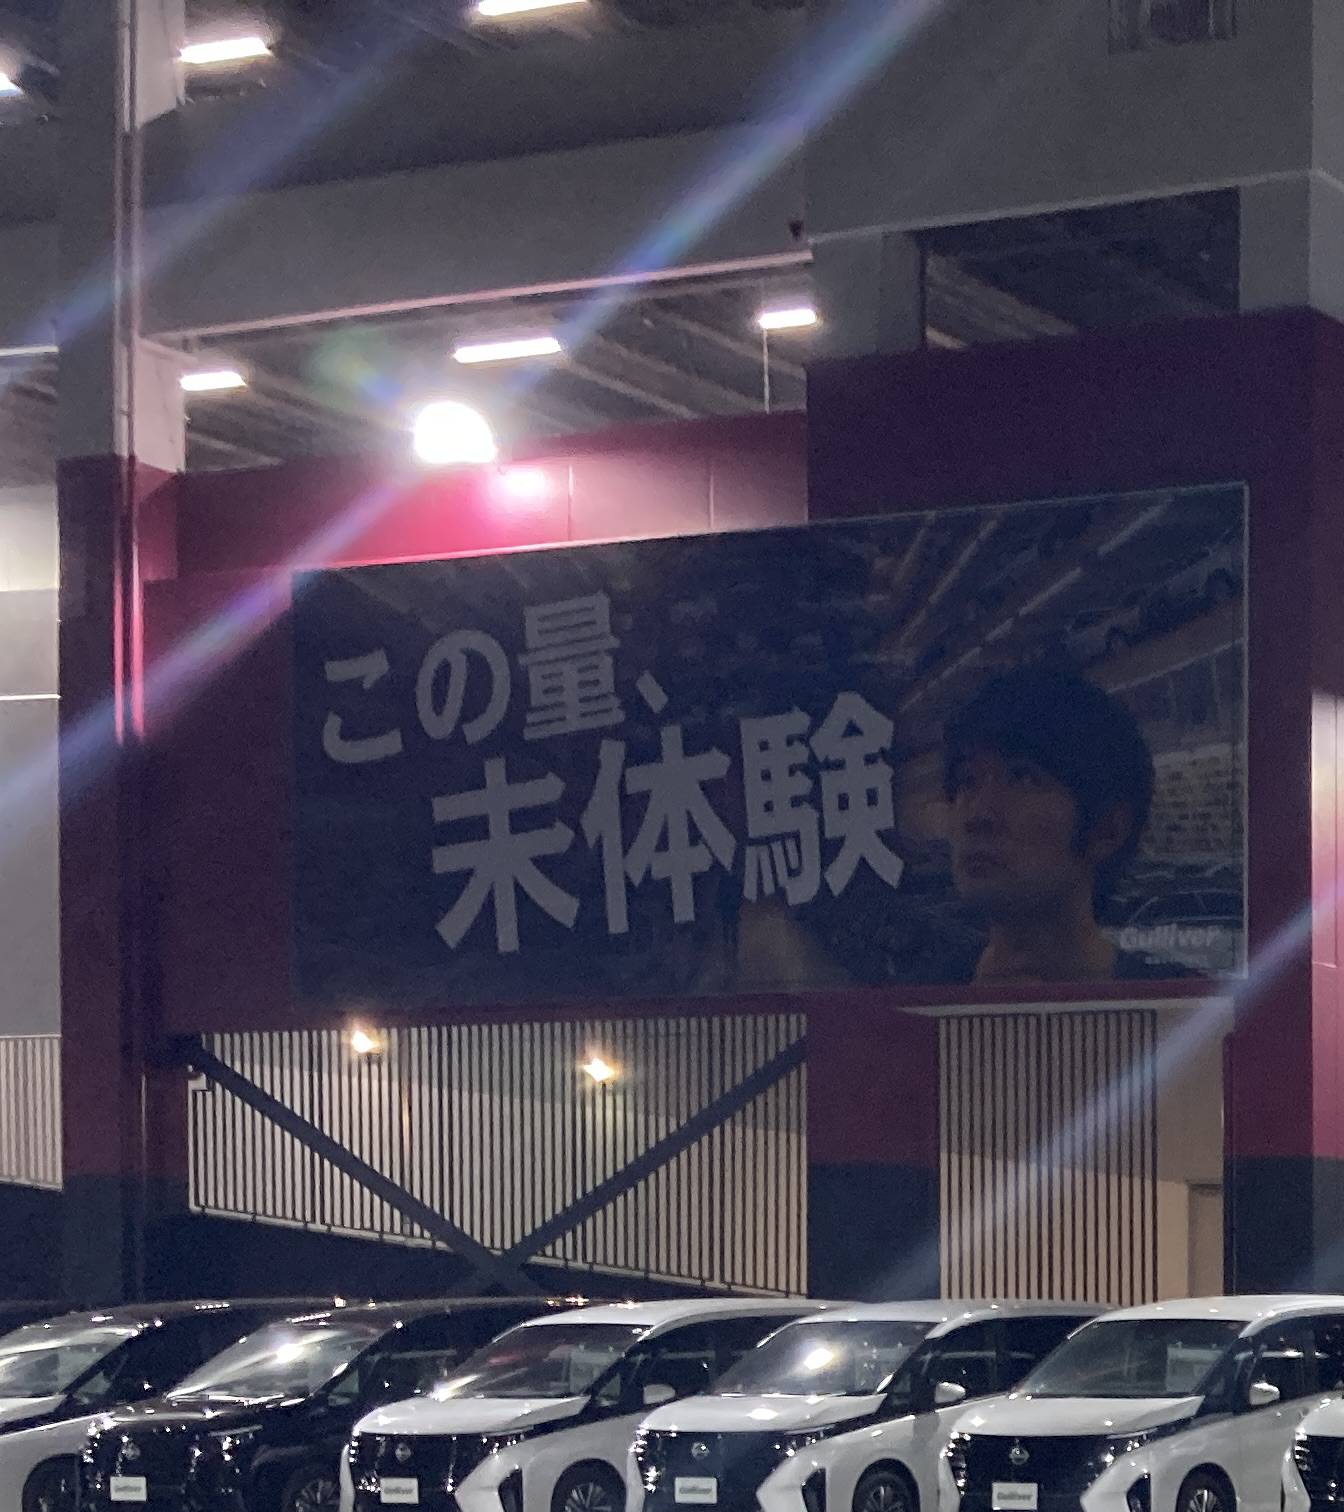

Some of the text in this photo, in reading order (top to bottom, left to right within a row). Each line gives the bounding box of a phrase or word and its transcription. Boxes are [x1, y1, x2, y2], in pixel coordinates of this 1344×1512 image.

[323, 590, 668, 764] この量、
[431, 690, 905, 953] 未体験
